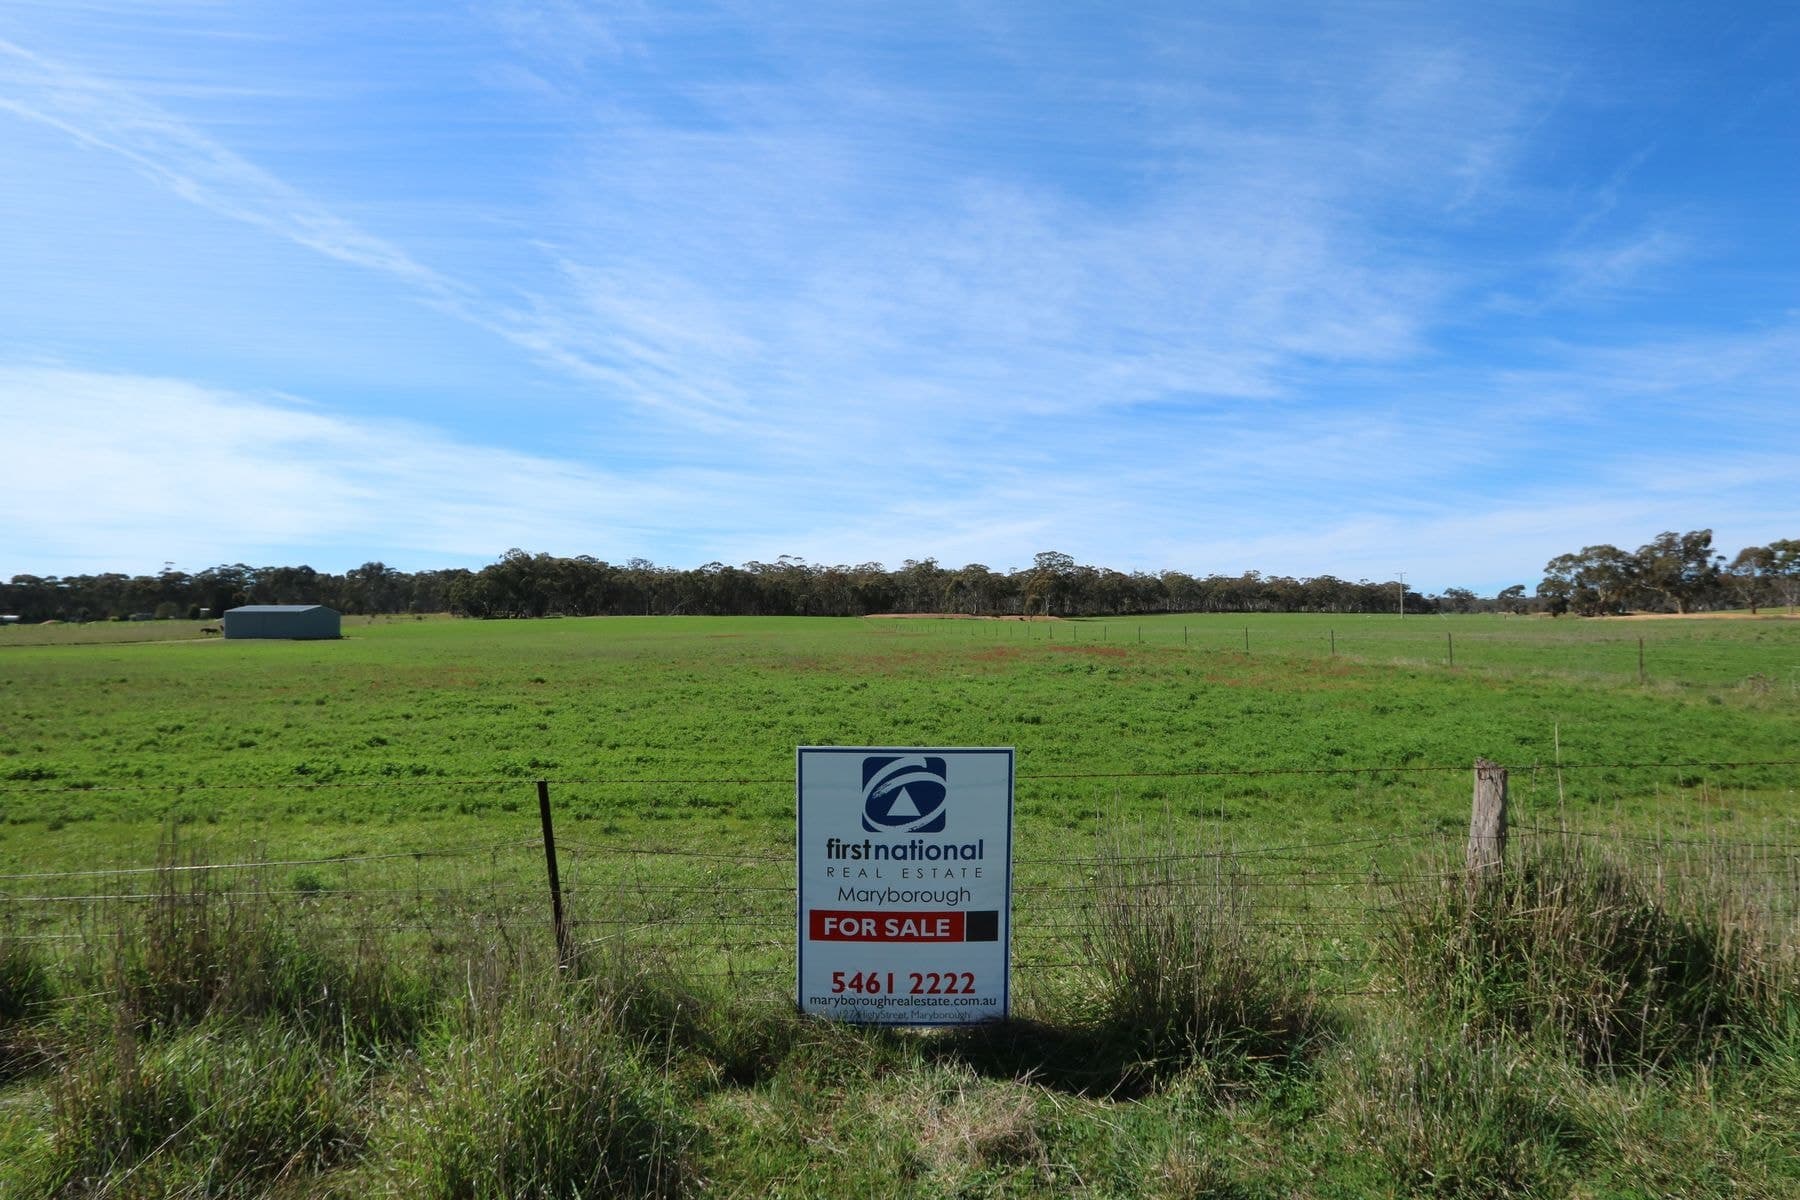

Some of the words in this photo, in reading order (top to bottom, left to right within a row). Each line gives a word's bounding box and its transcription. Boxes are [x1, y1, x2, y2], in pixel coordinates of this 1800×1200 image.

[826, 866, 882, 879] REAL
[902, 867, 983, 879] ESTATE
[838, 886, 971, 906] Maryborough
[824, 917, 877, 936] FOR
[885, 918, 950, 937] SALE
[831, 971, 895, 995] 5461
[909, 972, 976, 995] 2222
[809, 995, 997, 1009] maryboroughrealestate.com.au
[911, 1010, 970, 1020] Maryborough
